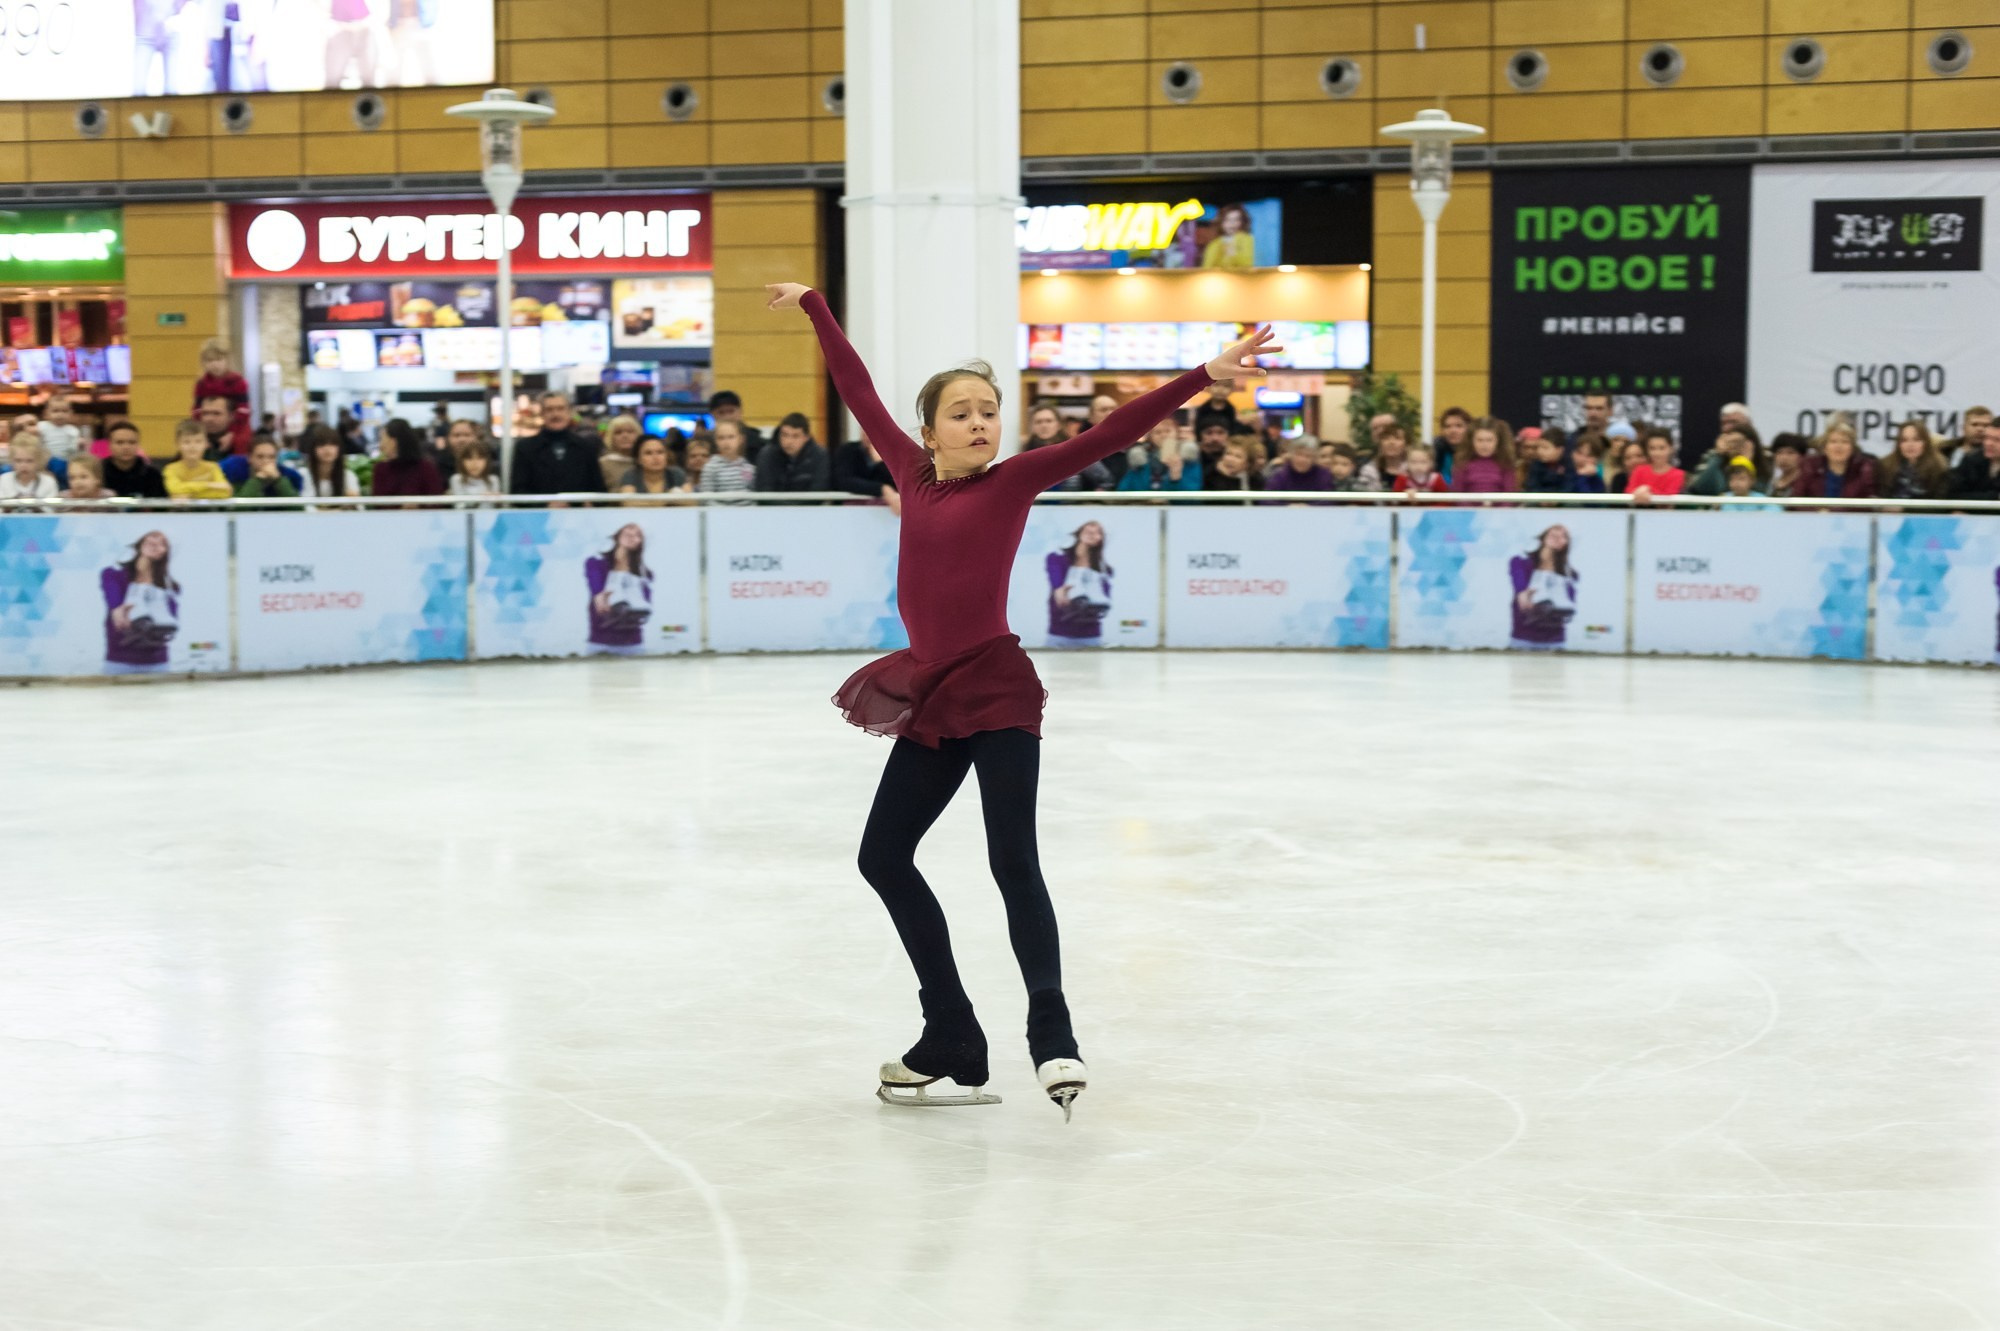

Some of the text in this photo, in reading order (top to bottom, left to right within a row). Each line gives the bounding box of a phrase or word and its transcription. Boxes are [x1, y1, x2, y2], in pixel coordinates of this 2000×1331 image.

[1515, 195, 1719, 241] ПРОБУЙ
[318, 209, 701, 263] БУРГЕР КИНГ
[1514, 254, 1689, 292] НОВОЕ
[1542, 312, 1685, 334] #МЕНЯЙСЯ
[1833, 364, 1946, 396] СКОРО
[1797, 409, 1960, 441] ОРЫТИ
[259, 564, 315, 582] КАТОК
[729, 554, 782, 571] КАТОК
[1187, 552, 1240, 570] КАТОК
[1656, 556, 1711, 574] КАТОК
